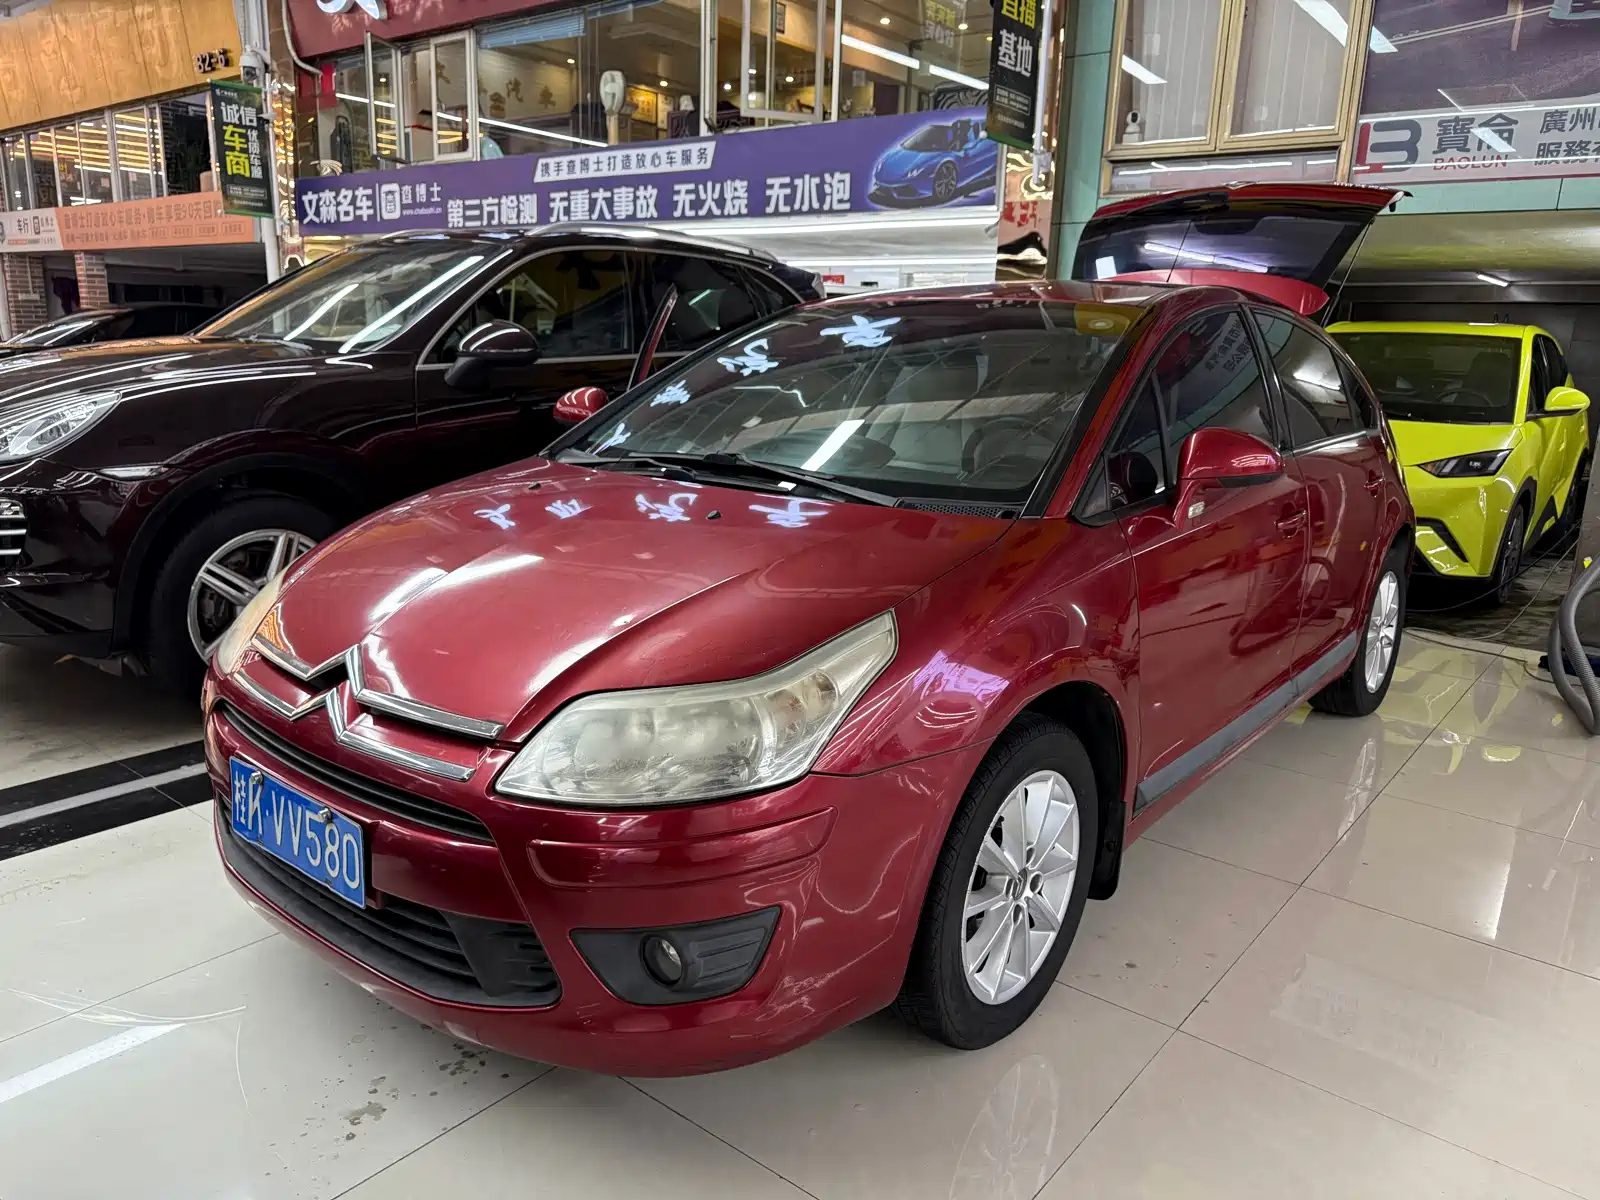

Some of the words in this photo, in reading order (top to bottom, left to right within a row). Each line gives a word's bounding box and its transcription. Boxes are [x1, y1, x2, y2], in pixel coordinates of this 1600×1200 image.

[997, 28, 1033, 78] 基地
[220, 101, 257, 127] 诚信
[1540, 107, 1600, 134] 廣州
[222, 124, 251, 178] 车商
[541, 147, 708, 178] 携手查博士打造放心车服务
[1433, 154, 1509, 171] BAOLUN
[302, 186, 373, 225] 文森名车
[401, 182, 442, 204] 查博士
[447, 193, 538, 228] 第三方检测
[549, 184, 659, 223] 无重大事故
[672, 178, 749, 218] 无火烧
[765, 171, 851, 214] 无水泡
